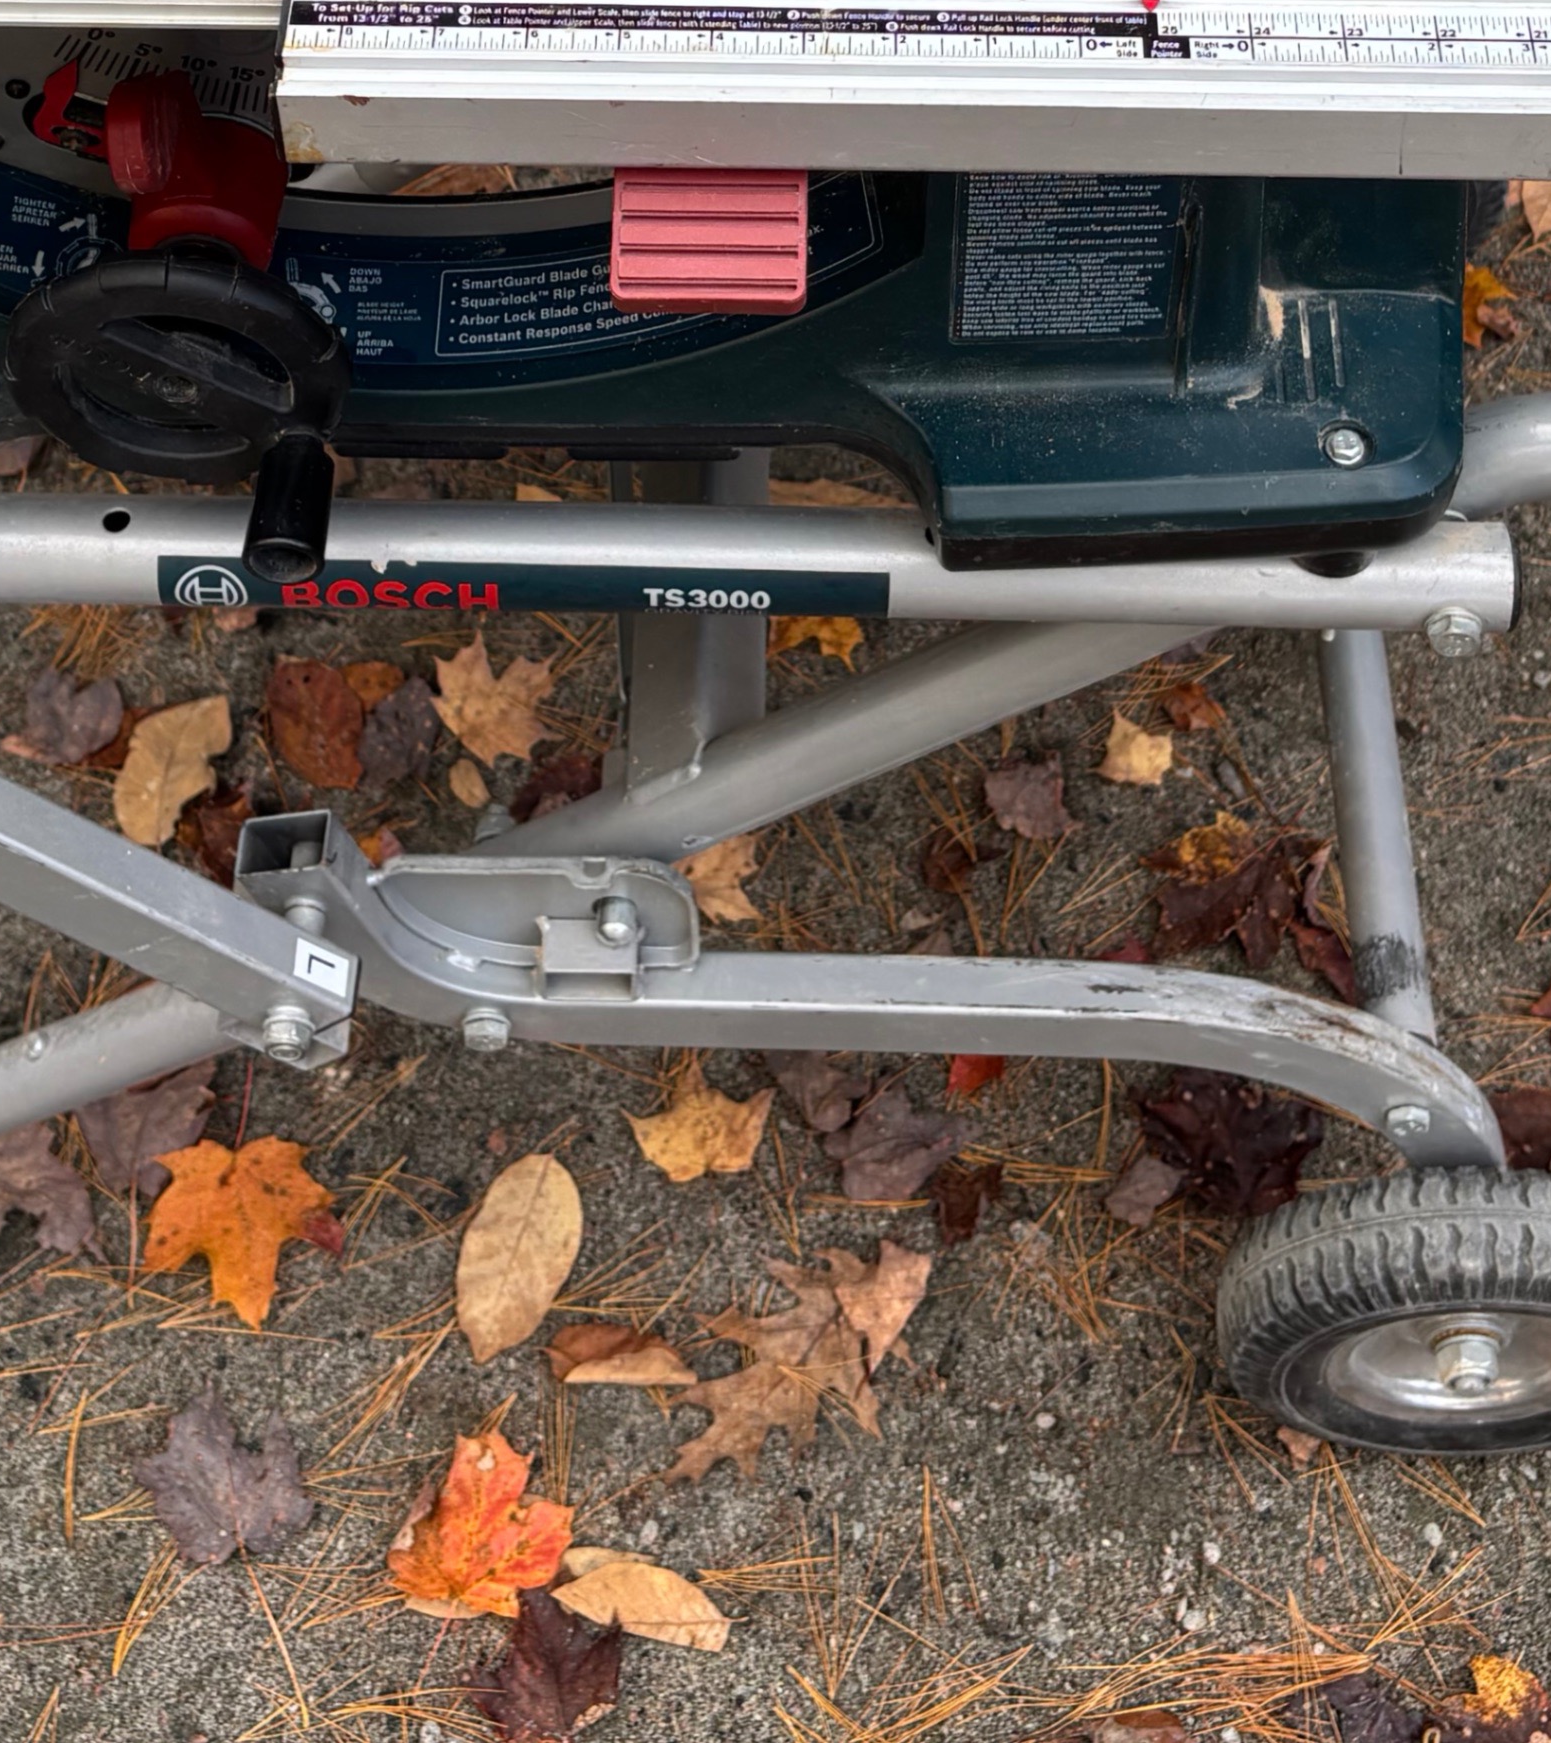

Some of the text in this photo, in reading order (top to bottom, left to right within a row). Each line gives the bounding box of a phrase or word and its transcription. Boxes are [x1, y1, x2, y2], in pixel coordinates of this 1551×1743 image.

[312, 3, 327, 12] To
[377, 4, 395, 13] for
[399, 5, 420, 16] Rip
[424, 5, 454, 15] Cuts
[473, 7, 492, 15] Look
[317, 14, 348, 23] from
[399, 16, 413, 24] to
[439, 28, 446, 37] 7
[531, 30, 538, 39] 6
[623, 31, 631, 40] 5
[716, 32, 724, 41] 4
[808, 33, 815, 42] 3
[900, 35, 907, 44] 2
[1161, 26, 1178, 35] 25
[1254, 27, 1271, 35] 24
[1347, 28, 1364, 37] 23
[1440, 29, 1456, 38] 22
[1534, 30, 1548, 39] 21
[1116, 40, 1136, 49] Left
[1152, 40, 1180, 49] Fence
[1194, 41, 1219, 52] Right
[1427, 43, 1436, 52] 2
[1522, 43, 1531, 52] 3
[1116, 49, 1138, 58] Side
[1151, 49, 1183, 59] Pointer
[1196, 51, 1217, 59] Side
[135, 43, 163, 58] 5°
[180, 55, 217, 72] 10°
[230, 66, 266, 83] 15°
[13, 196, 56, 211] TIGHTEN
[12, 205, 57, 221] APRETAR
[349, 268, 381, 276] DOWN
[349, 277, 383, 285] ABAJO
[461, 264, 612, 292] SmartGuard Blade Gu
[553, 286, 576, 304] Rip
[459, 311, 500, 328] Arbor
[504, 308, 535, 325] Lock
[537, 304, 579, 322] Blade
[582, 300, 614, 316] Cha
[458, 329, 521, 346] Constant
[525, 322, 592, 343] Response
[596, 313, 639, 334] Speed
[357, 339, 394, 347] ARRIBA
[356, 348, 383, 356] HAUT
[280, 578, 500, 612] BOSCH
[643, 588, 771, 610] TS3000
